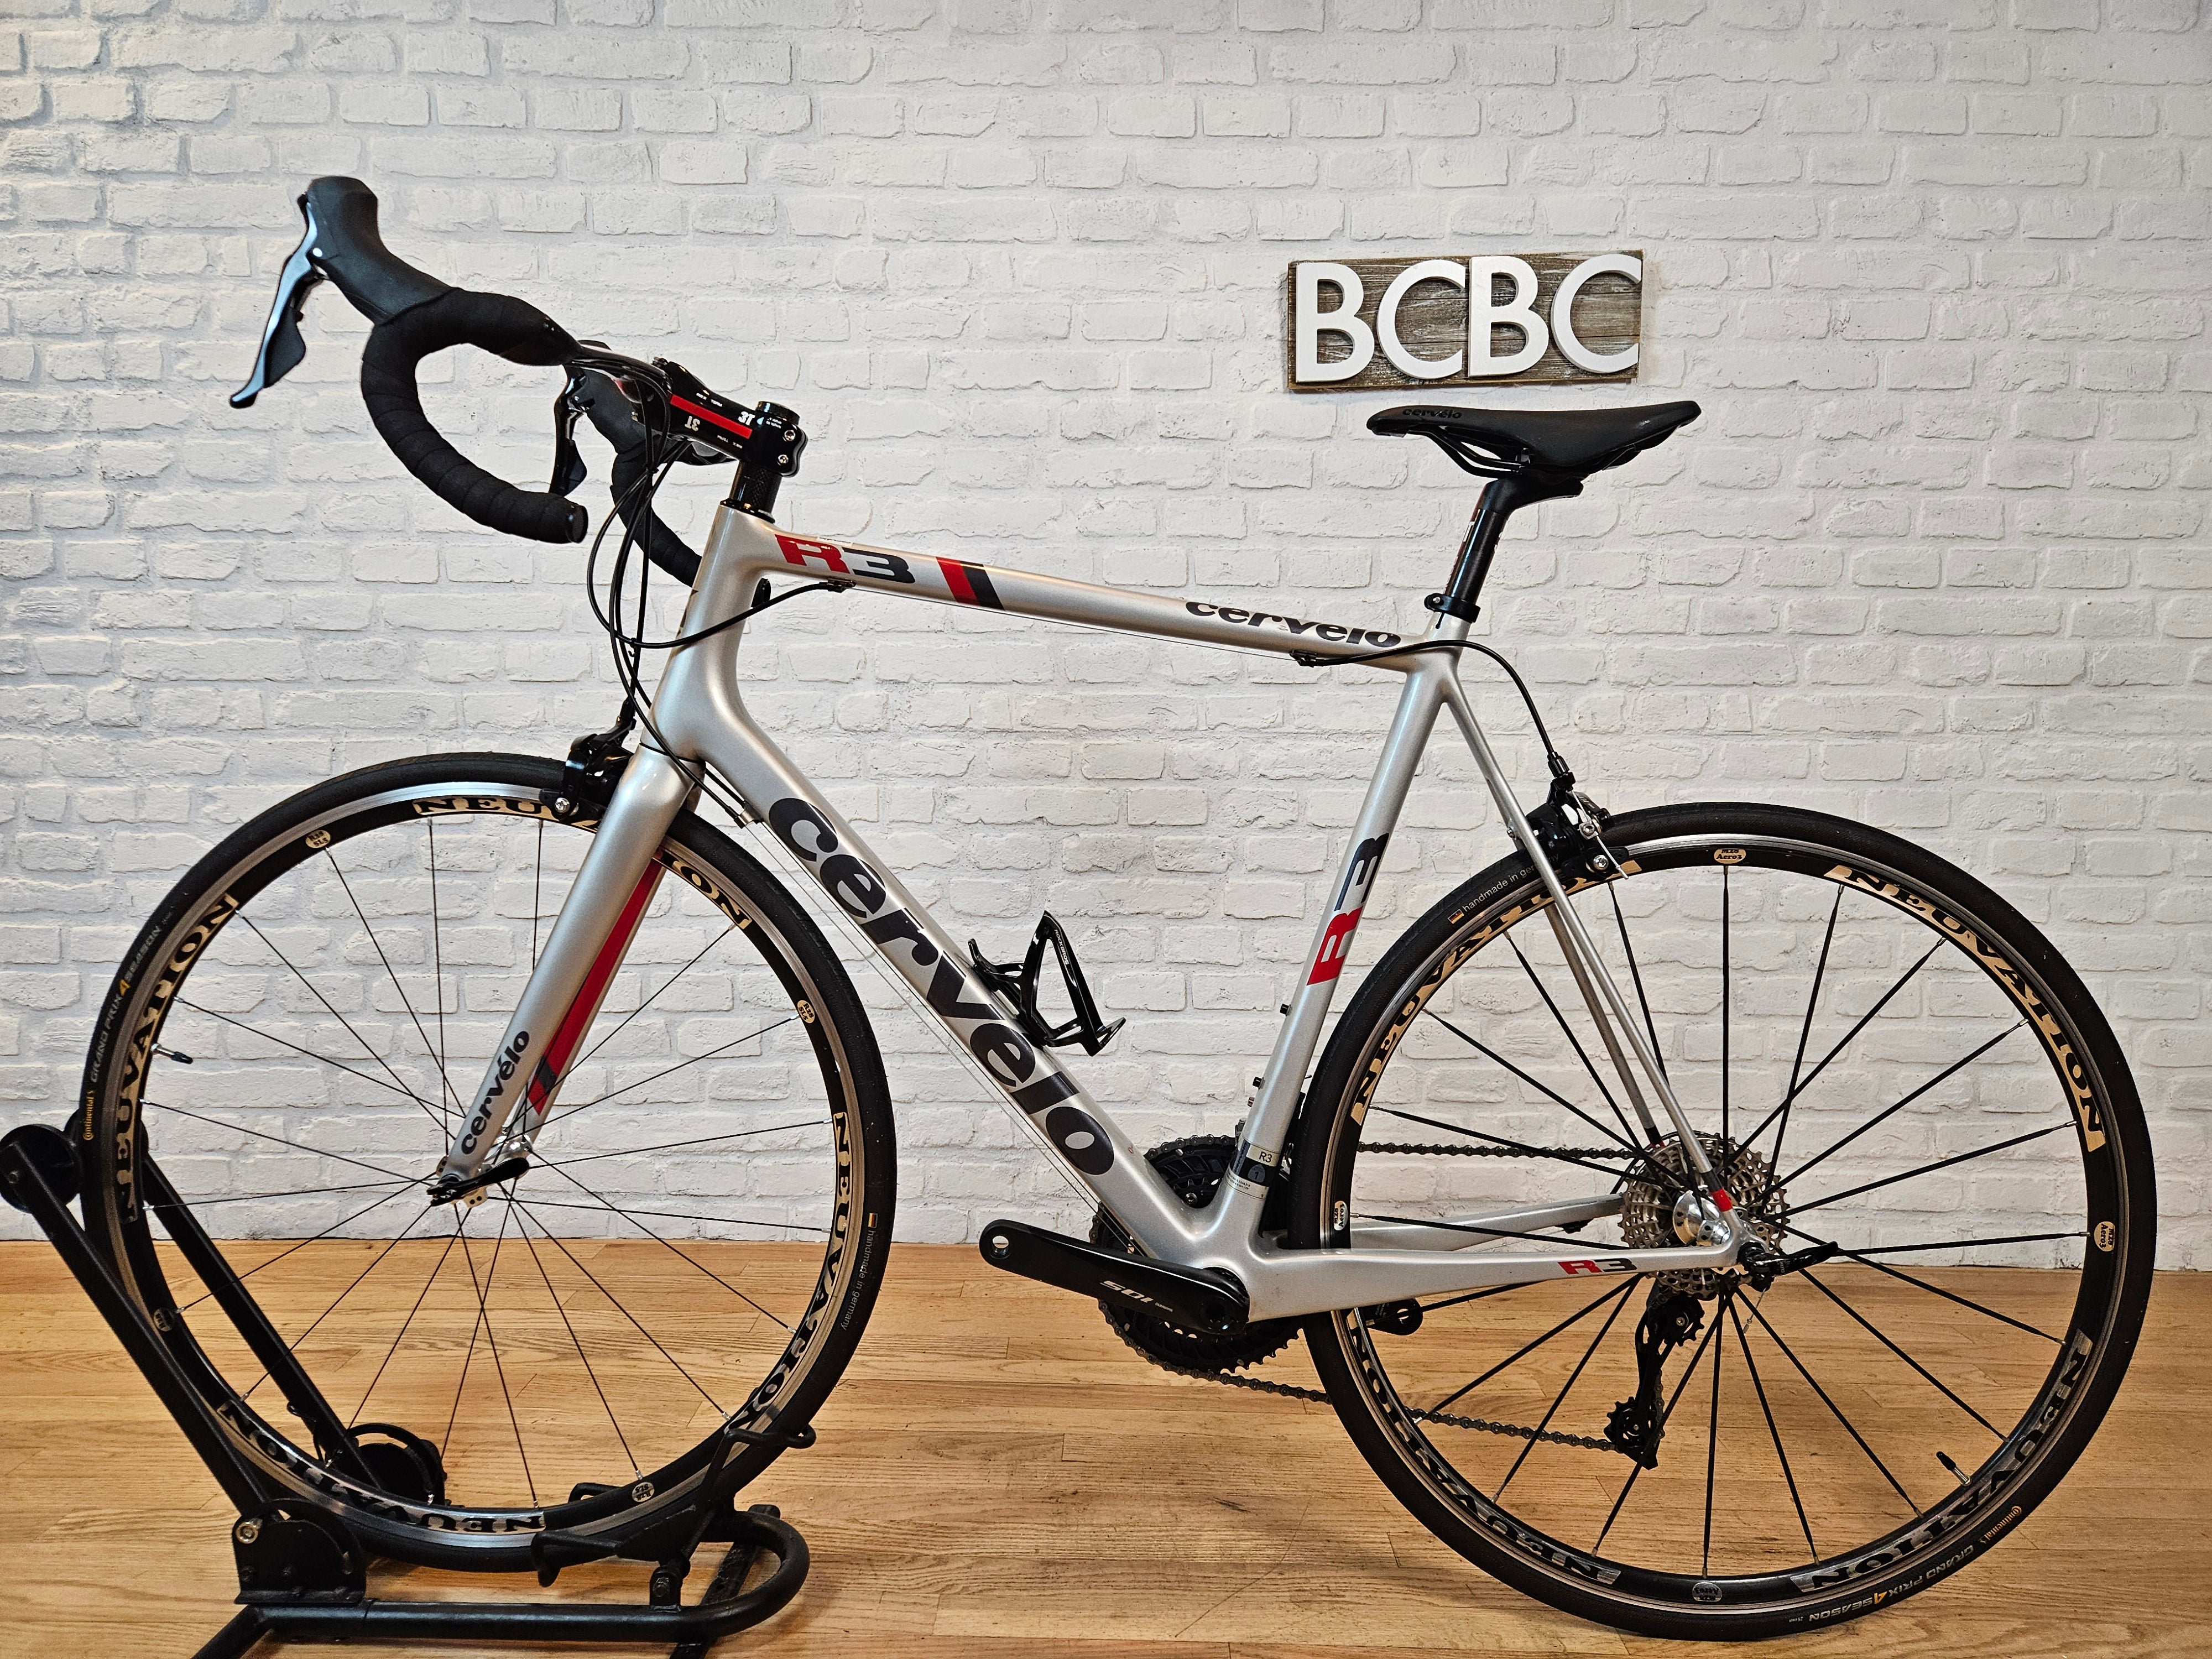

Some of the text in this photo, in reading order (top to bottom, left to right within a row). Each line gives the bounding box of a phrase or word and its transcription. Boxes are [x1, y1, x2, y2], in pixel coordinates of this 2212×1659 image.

[1296, 253, 1642, 383] BCBC
[684, 415, 701, 431] 3T
[738, 411, 755, 426] 3T
[774, 534, 916, 583] R3
[1462, 852, 1558, 912] handmade in gerny
[1307, 833, 1389, 985] R3
[1054, 928, 1070, 966] ROCKBROS
[798, 1006, 808, 1020] SL5
[803, 1003, 814, 1018] R28
[88, 1029, 109, 1083] GRAND
[103, 992, 123, 1030] PRIX
[461, 1031, 529, 1155] cervélo
[82, 1095, 95, 1141] Continental
[1259, 1151, 1272, 1163] R3
[1254, 1171, 1259, 1180] 1
[2099, 1223, 2108, 1248] Aero3
[728, 1115, 852, 1430] NEUVATION
[841, 1230, 873, 1331] handmade in germany
[1558, 1258, 1637, 1275] R3
[1100, 1280, 1155, 1303] 105
[1983, 1507, 2021, 1541] Continental
[1925, 1545, 1974, 1580] GRAND
[1887, 1574, 1924, 1597] PRIX
[1808, 1597, 1874, 1621] SEASON
